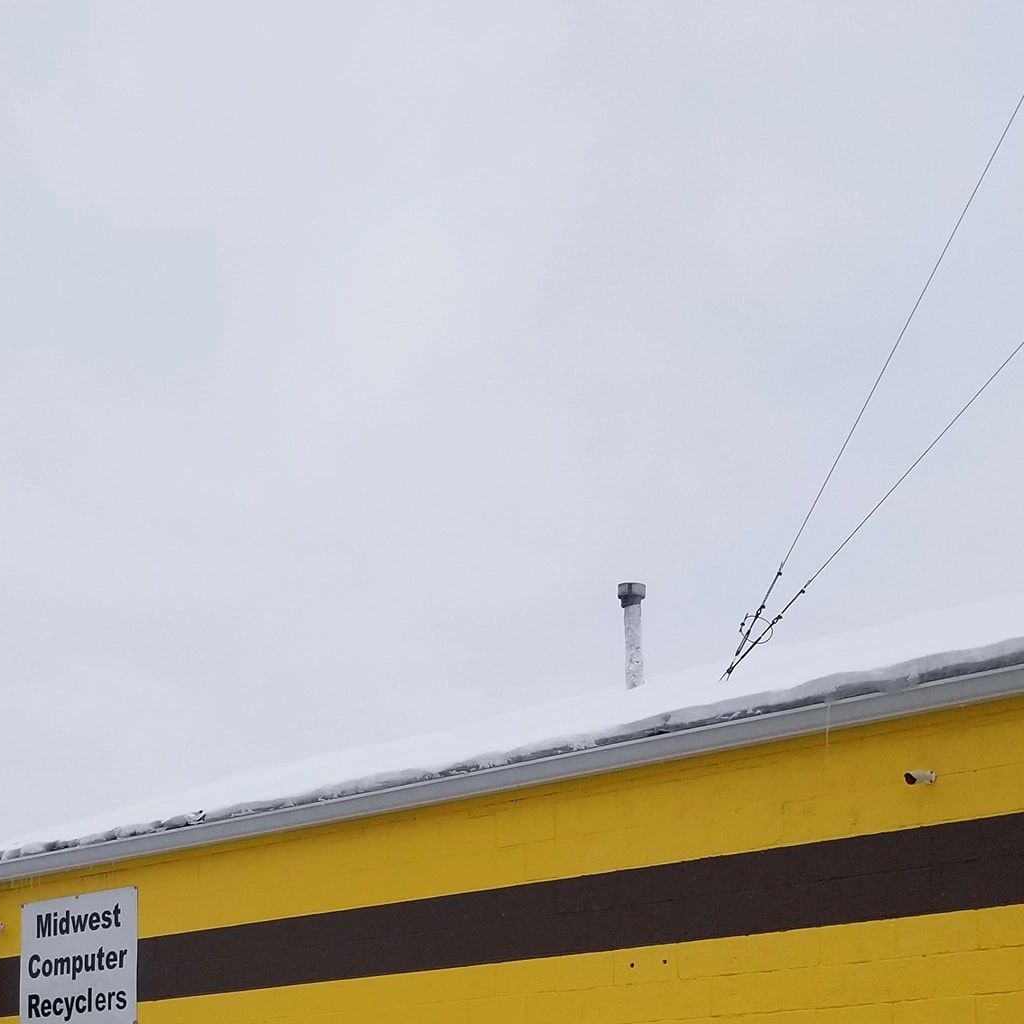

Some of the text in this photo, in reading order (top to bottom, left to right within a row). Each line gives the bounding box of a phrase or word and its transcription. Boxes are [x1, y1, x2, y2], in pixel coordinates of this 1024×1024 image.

[36, 903, 121, 939] Midwest
[28, 946, 127, 980] Computer
[28, 988, 127, 1021] Recyclers
